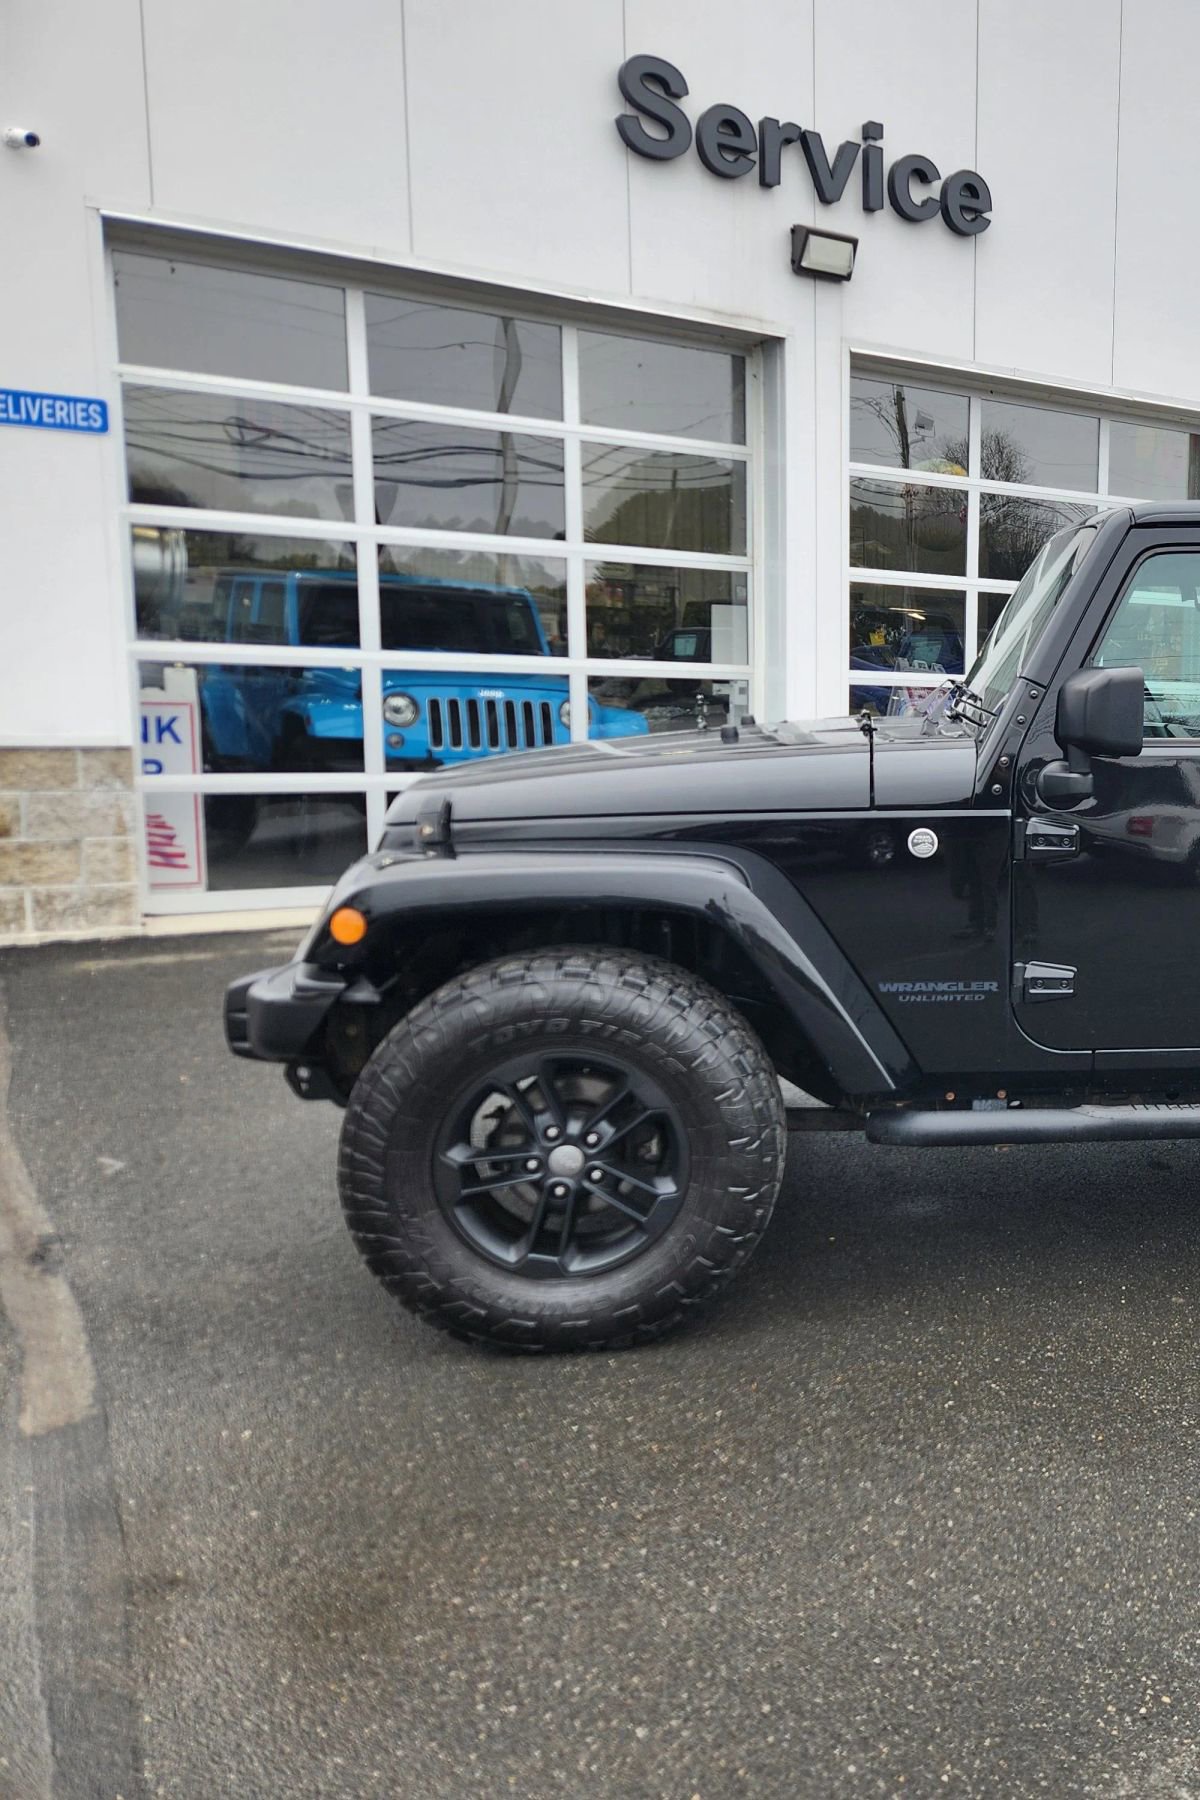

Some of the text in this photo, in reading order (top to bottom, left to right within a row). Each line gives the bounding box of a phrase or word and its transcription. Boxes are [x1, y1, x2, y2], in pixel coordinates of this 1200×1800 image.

[615, 54, 993, 236] Service
[878, 981, 999, 992] WRANGLER
[898, 994, 986, 1002] UNLIMITED
